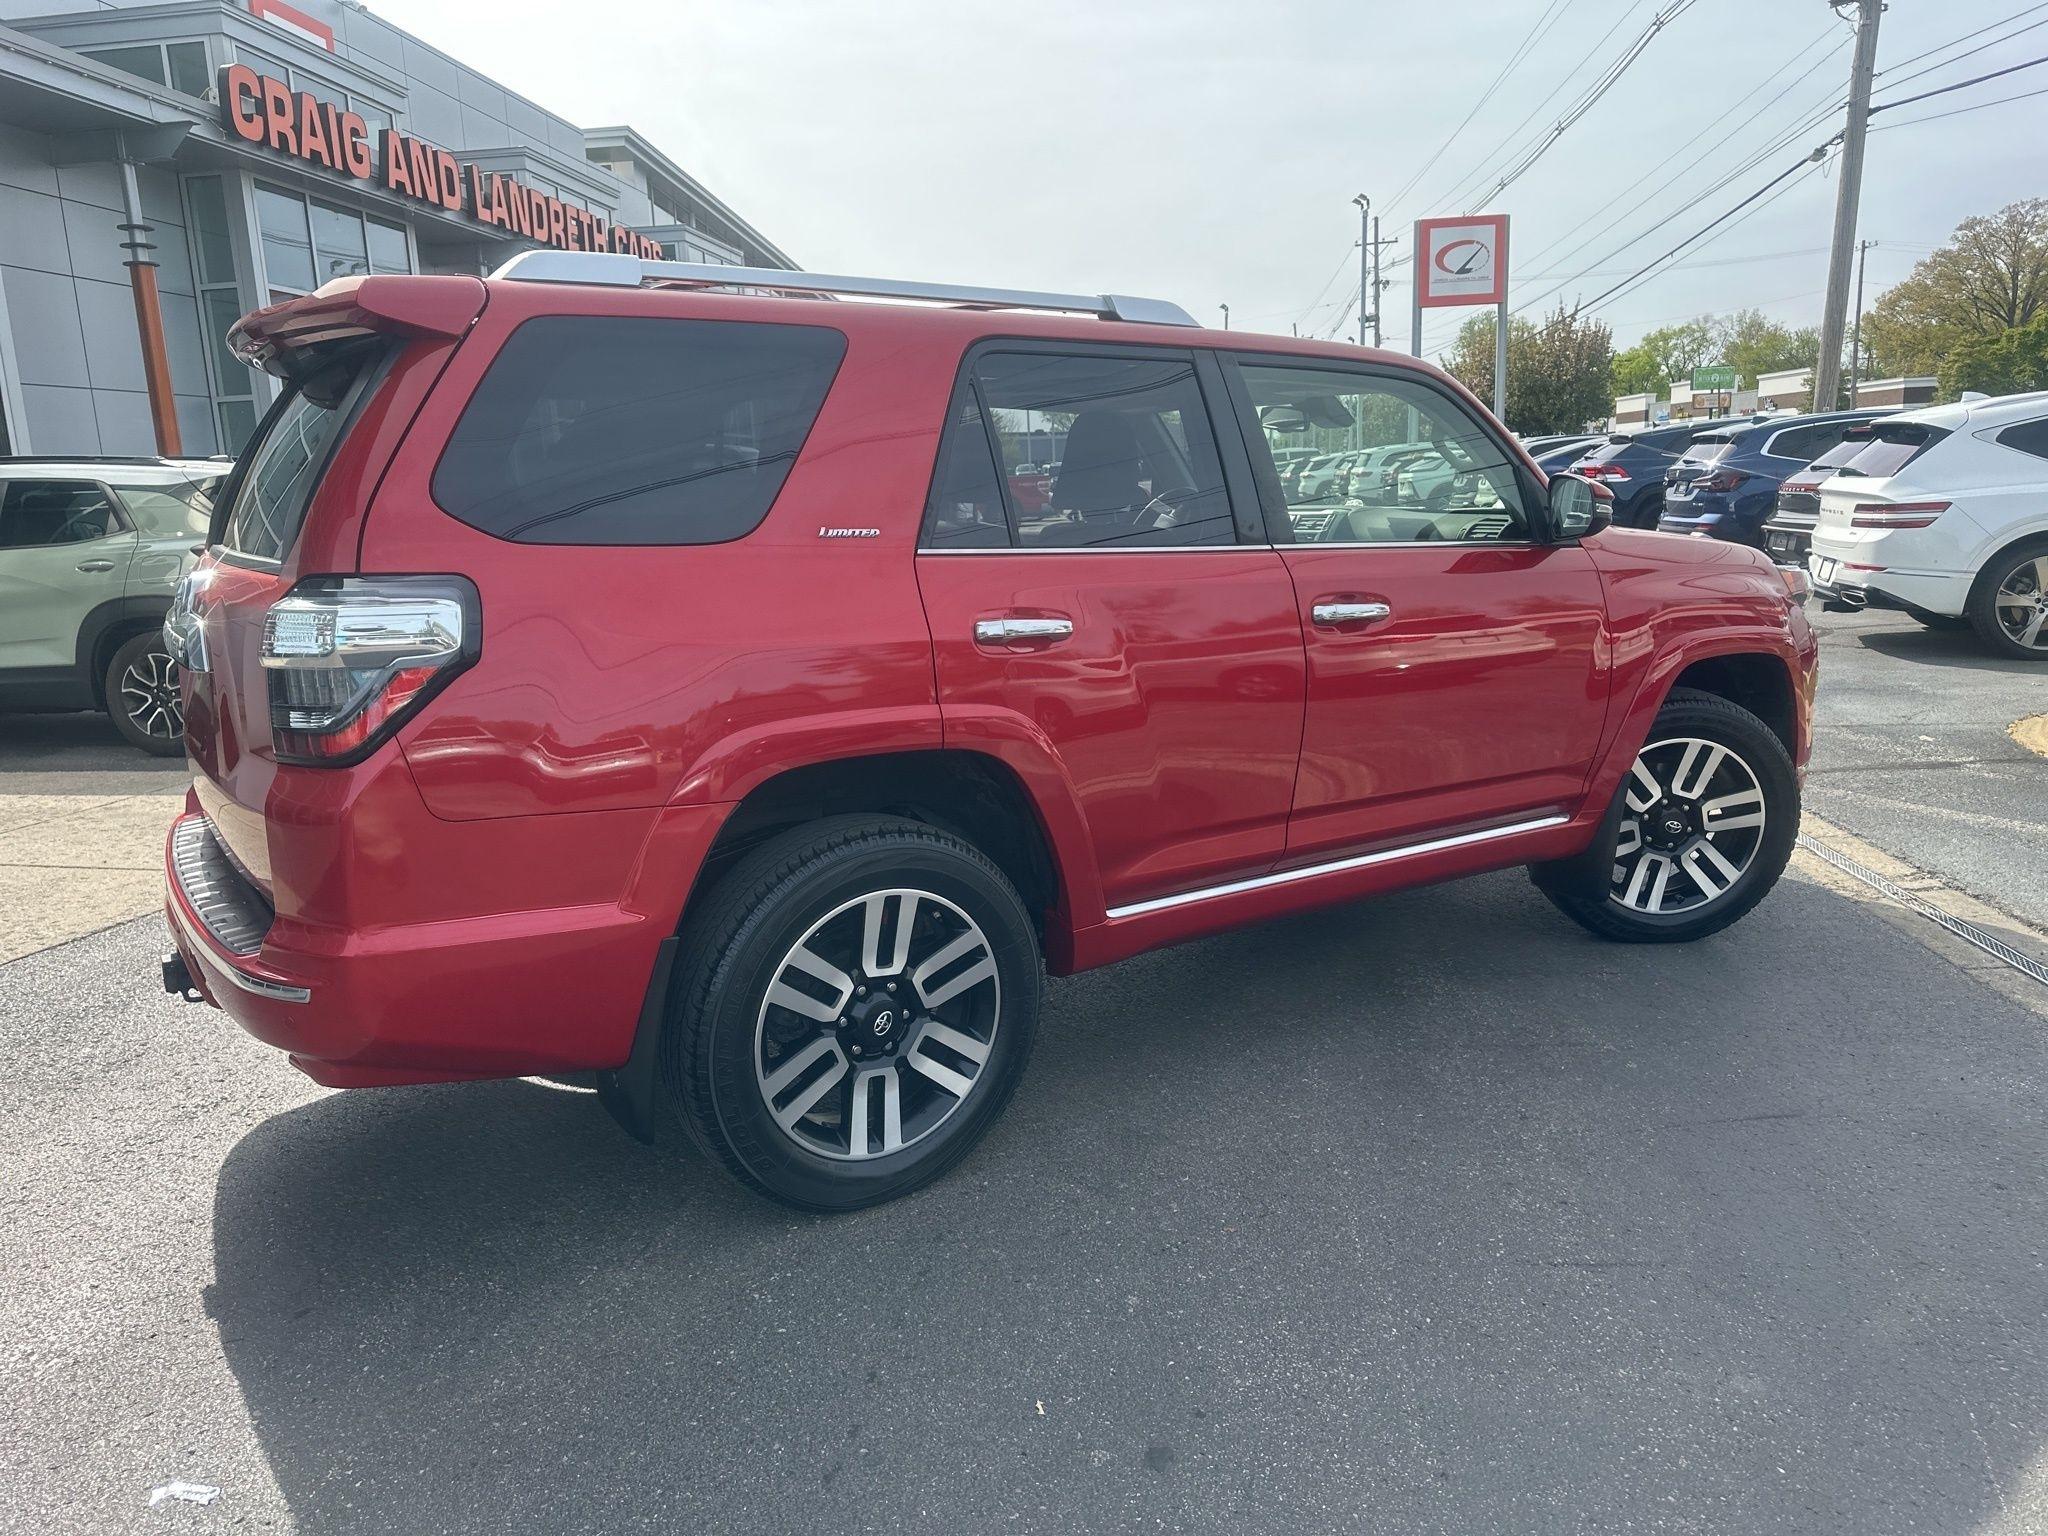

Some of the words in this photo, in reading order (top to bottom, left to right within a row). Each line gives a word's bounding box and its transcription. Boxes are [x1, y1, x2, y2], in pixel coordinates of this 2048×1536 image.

[226, 63, 372, 180] CRAIG
[386, 129, 462, 211] AND
[471, 163, 608, 252] LANDRETH
